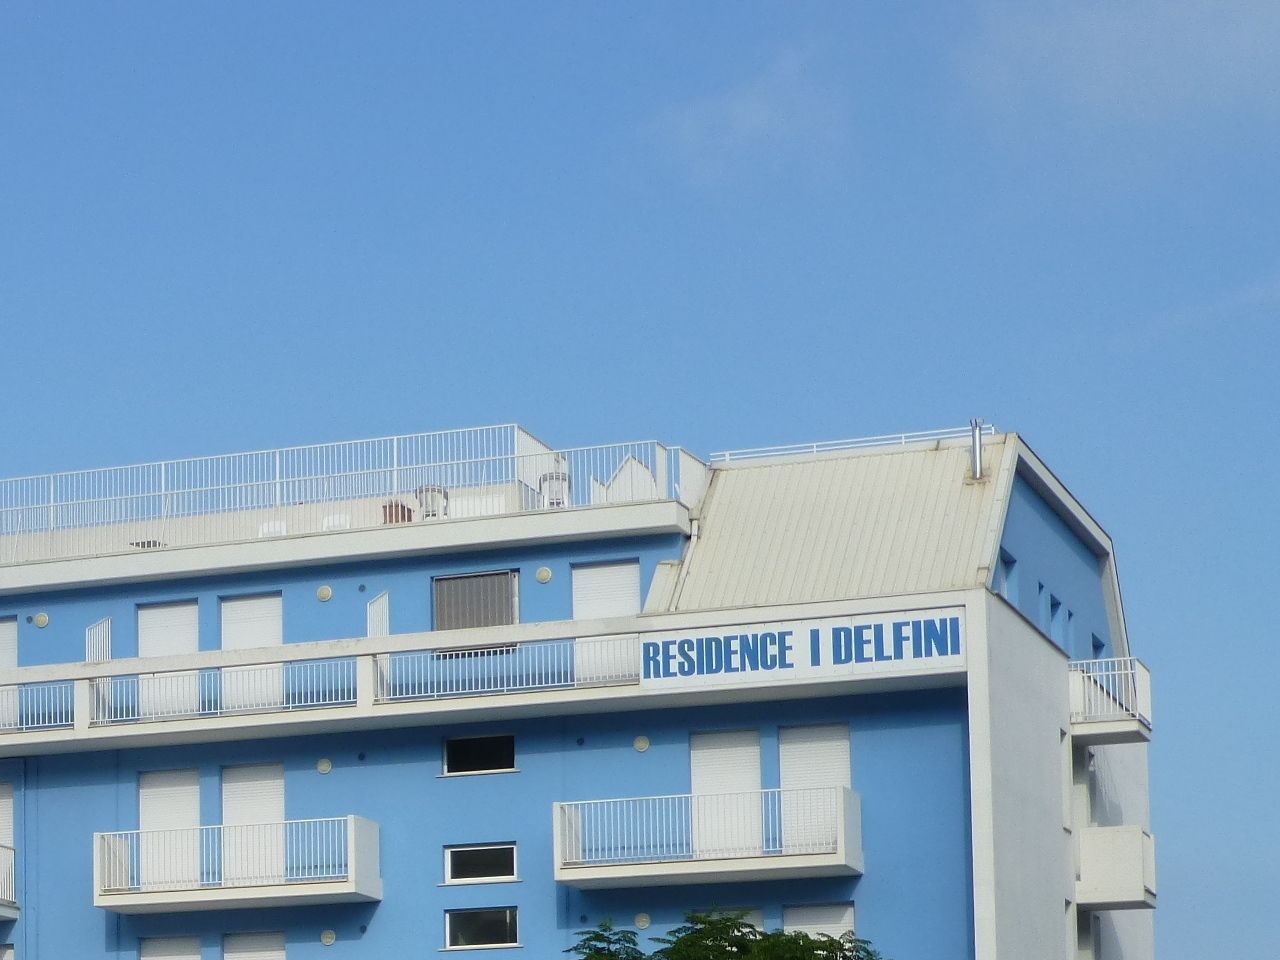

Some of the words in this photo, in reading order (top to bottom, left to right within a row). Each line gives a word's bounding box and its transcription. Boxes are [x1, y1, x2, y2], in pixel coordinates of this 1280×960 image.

[643, 631, 794, 679] RESIDENCE
[810, 628, 820, 667] I
[832, 617, 960, 665] DELFINI
